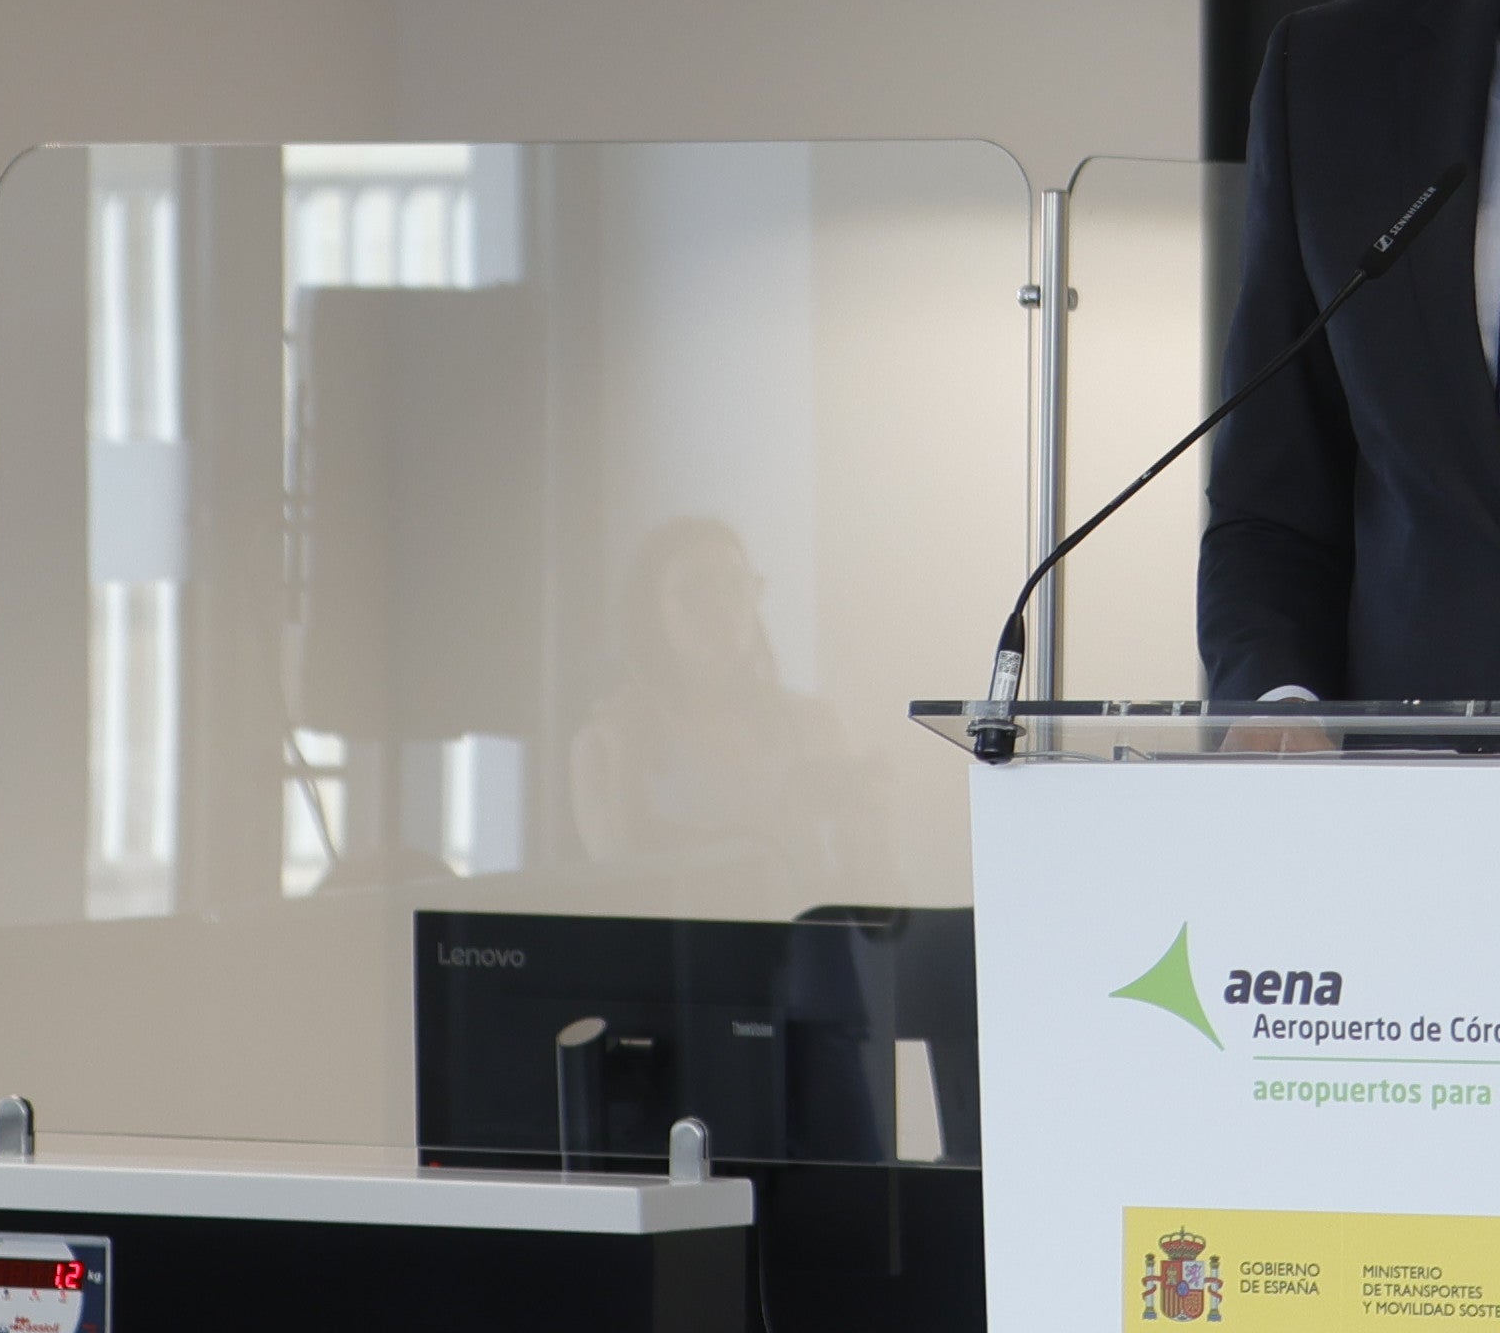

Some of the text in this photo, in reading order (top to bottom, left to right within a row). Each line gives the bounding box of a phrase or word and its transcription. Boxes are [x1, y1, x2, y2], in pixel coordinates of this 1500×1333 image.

[1389, 186, 1437, 236] SENNHEISER
[437, 941, 525, 968] Lenovo
[1223, 969, 1343, 1006] aena
[1253, 1013, 1401, 1046] Aeropuerto
[1410, 1016, 1442, 1042] de
[1253, 1079, 1422, 1108] aeropuertos
[1431, 1083, 1492, 1110] para
[1239, 1261, 1321, 1277] GOBIERNO
[1362, 1265, 1443, 1280] MINISTERIO
[1239, 1278, 1320, 1295] DE ESPAÑA
[1362, 1283, 1483, 1299] DE TRANSPORTES
[1362, 1301, 1372, 1314] Y
[1376, 1302, 1455, 1317] MOVILIDAD
